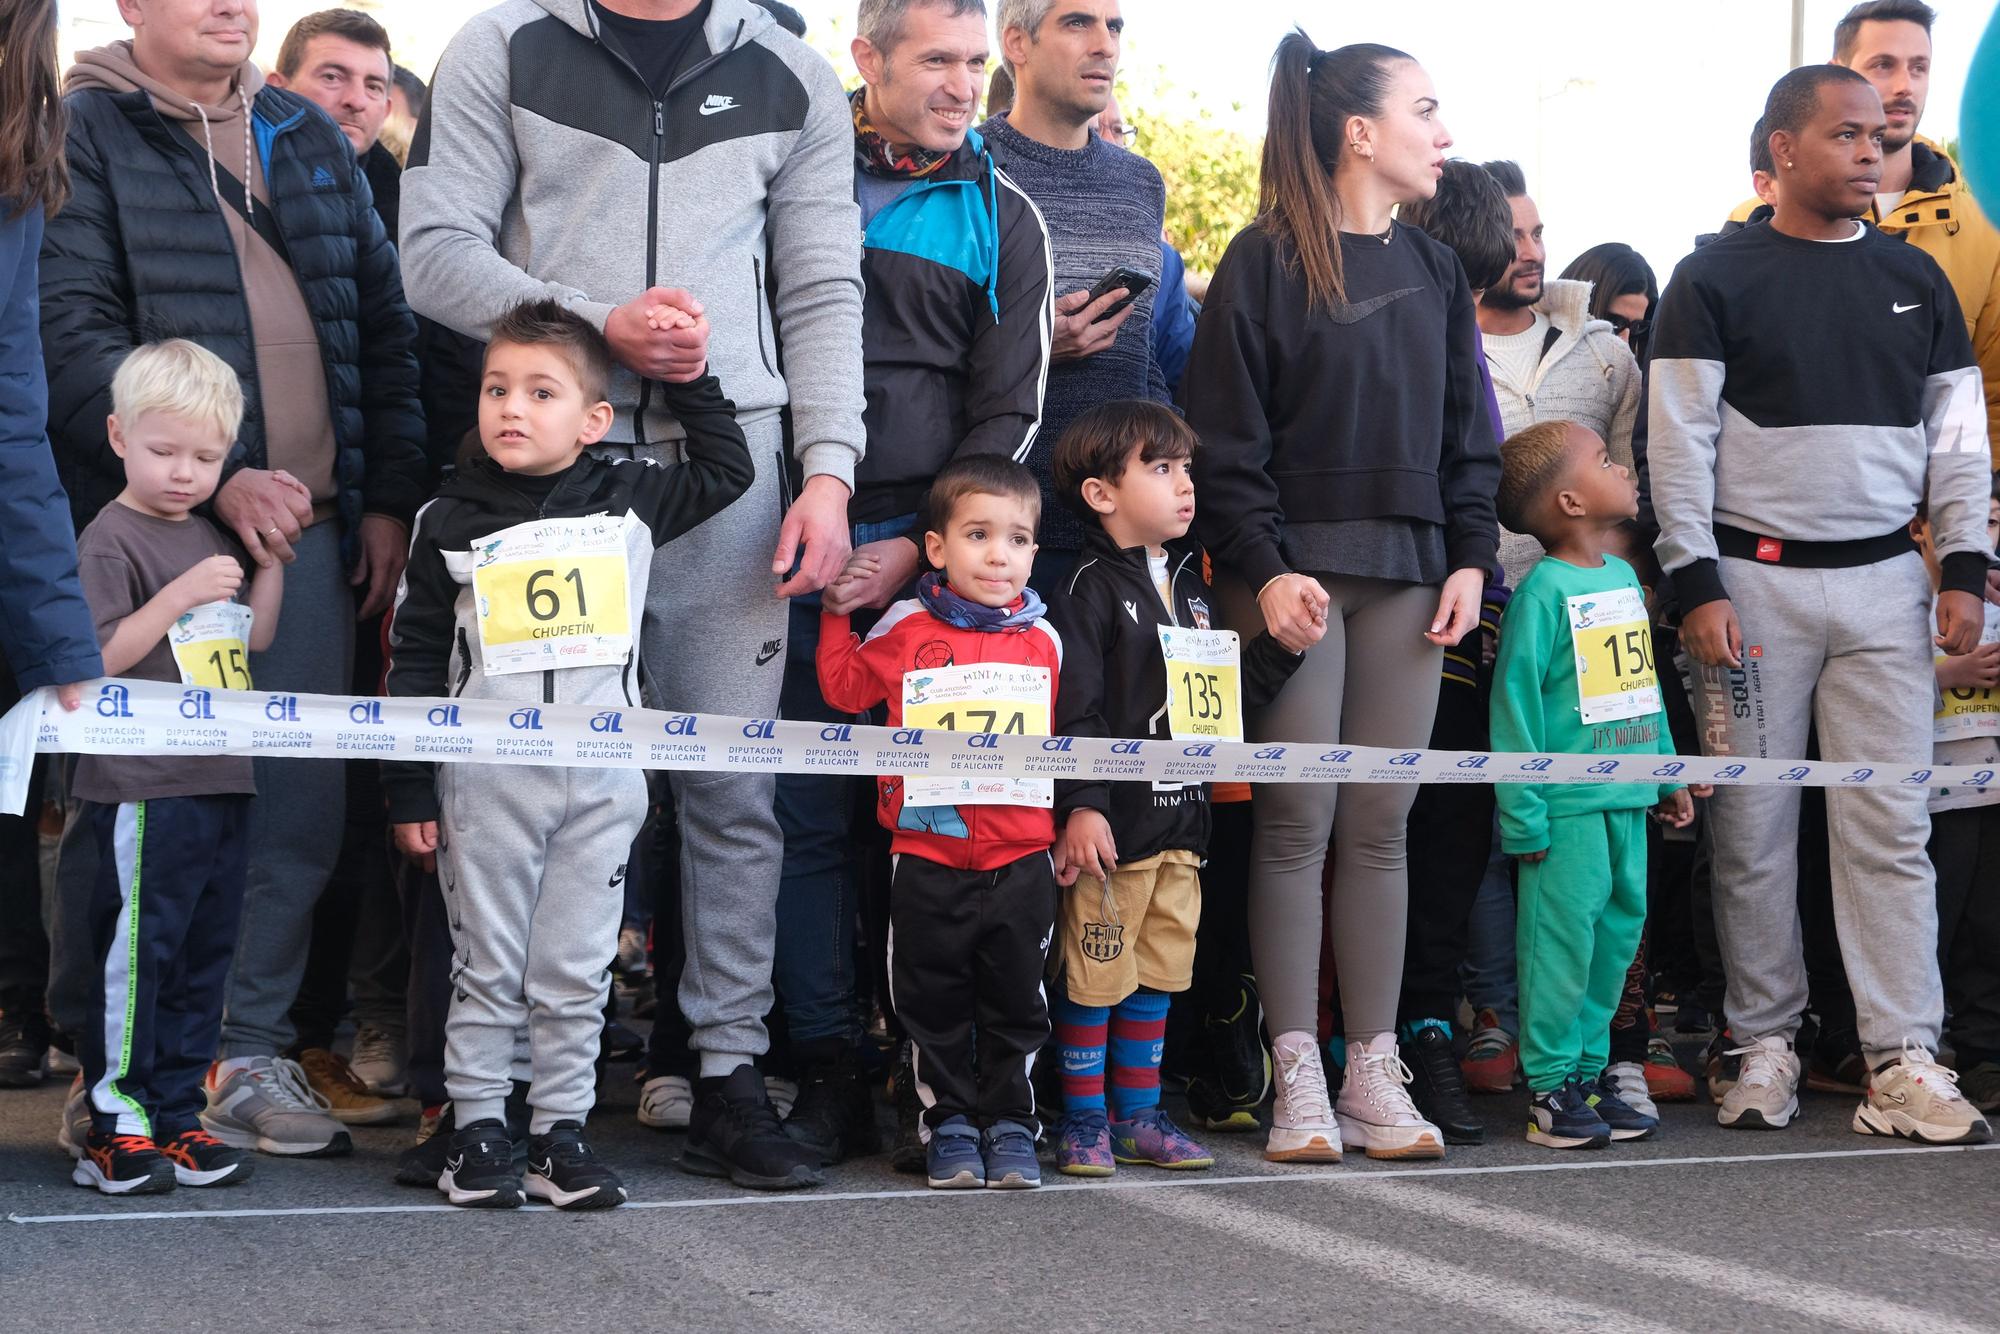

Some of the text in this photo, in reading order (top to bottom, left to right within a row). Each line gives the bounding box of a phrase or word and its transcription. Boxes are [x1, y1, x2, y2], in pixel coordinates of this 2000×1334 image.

[705, 94, 734, 107] NIKE
[526, 568, 587, 621] 61
[532, 621, 595, 639] CHUPETÍN
[761, 638, 782, 655] NIKE
[1604, 629, 1654, 677] 150
[1183, 671, 1223, 720] 135
[167, 729, 227, 737] DIPUTACIÓN
[253, 731, 312, 739] DIPUTACIÓN
[337, 733, 395, 742] DIPUTACIÓN
[416, 736, 472, 744] DIPUTACIÓN
[1592, 727, 1612, 750] IT'S
[166, 739, 227, 748] DE ALICANTE
[337, 742, 349, 750] DE
[497, 738, 553, 747] DIPUTACIÓN
[577, 741, 632, 750] DIPUTACIÓN
[415, 745, 472, 754] DE ALICANTE
[496, 748, 552, 756] DE ALICANTE
[652, 744, 706, 752] DIPUTACIÓN
[729, 746, 782, 755] DIPUTACIÓN
[577, 751, 632, 760] DE ALICANTE
[806, 749, 858, 757] DIPUTACIÓN
[877, 752, 929, 760] DIPUTACIÓN
[664, 754, 706, 762] ALICANTE
[741, 756, 783, 764] ALICANTE
[817, 758, 859, 766] ALICANTE
[952, 754, 1004, 762] DIPUTACIÓN
[1026, 756, 1077, 764] DIPUTACIÓN
[876, 760, 887, 768] DE
[951, 762, 962, 770] DE
[1025, 764, 1035, 772] DE
[1301, 766, 1351, 774] DIPUTACIÓN
[1063, 1050, 1103, 1060] CULERS
